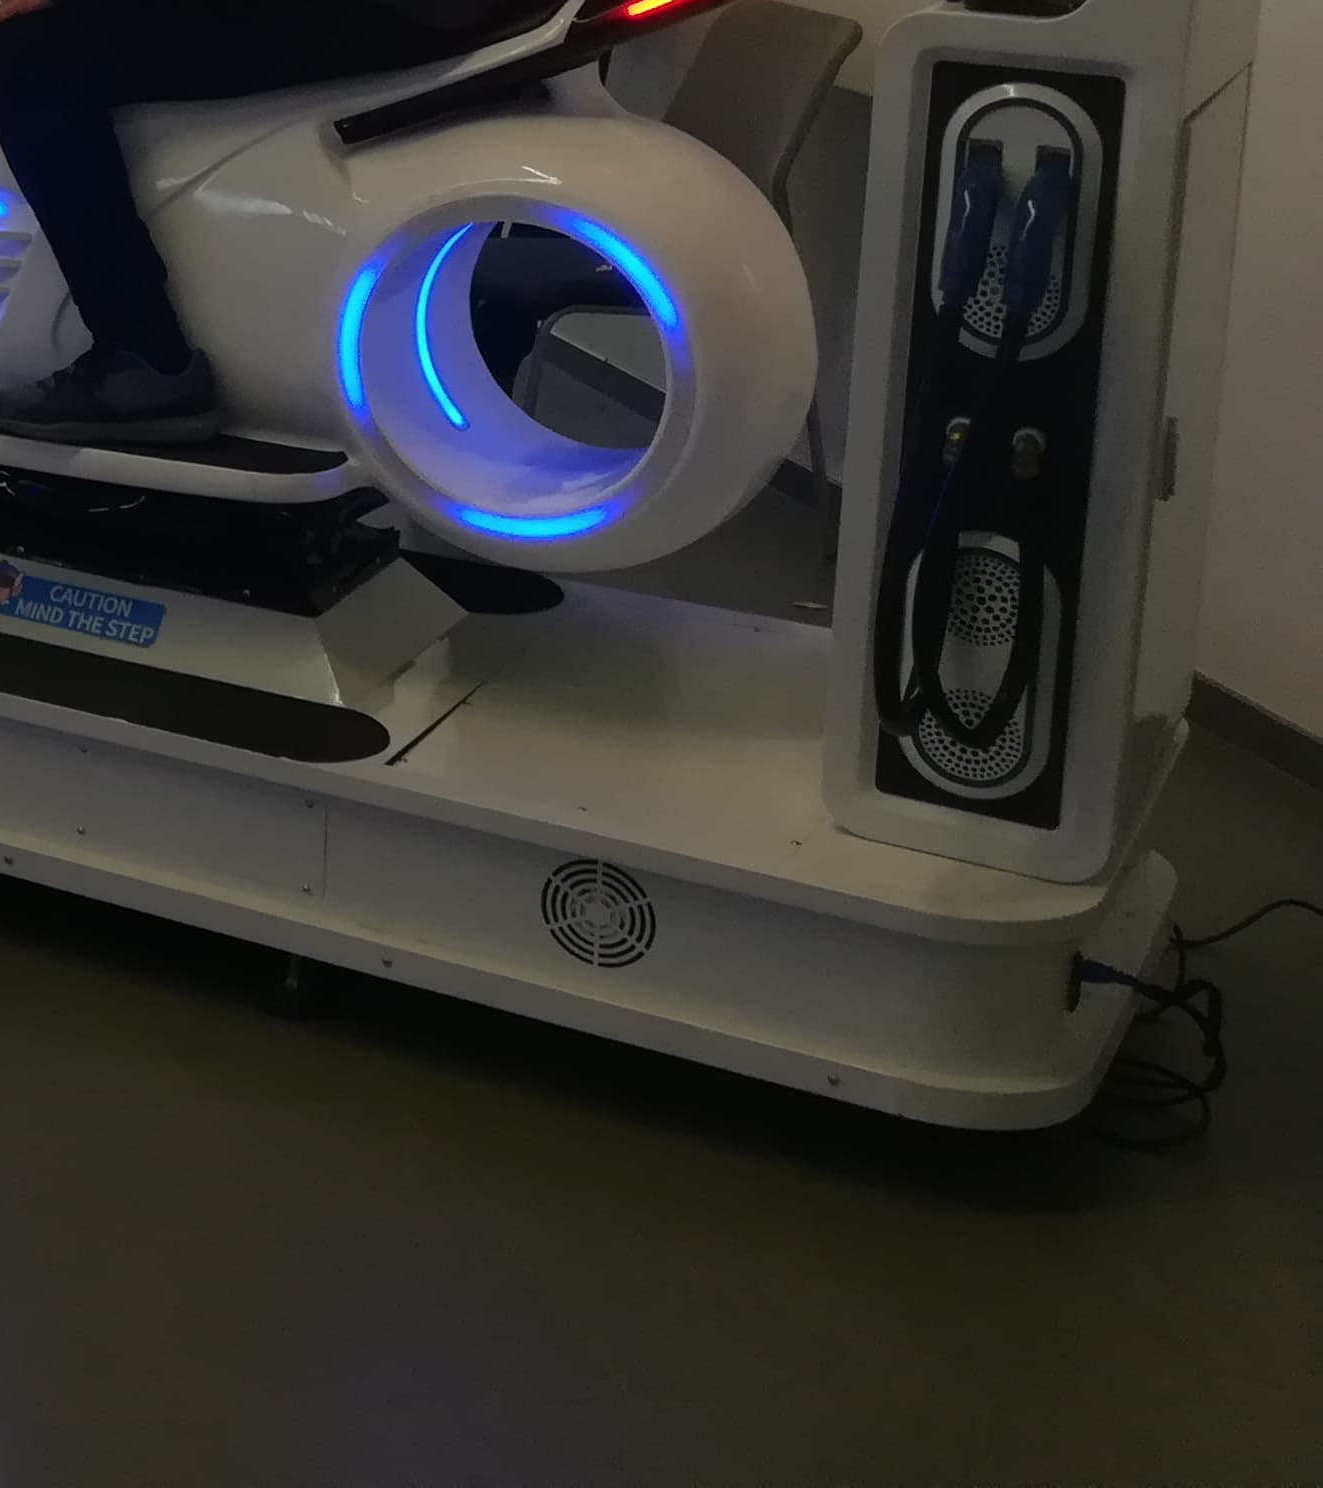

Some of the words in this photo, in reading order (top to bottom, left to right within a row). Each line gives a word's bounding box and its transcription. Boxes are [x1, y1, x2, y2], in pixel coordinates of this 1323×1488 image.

[14, 598, 64, 625] MIND
[67, 609, 106, 634] THE
[105, 620, 156, 644] STEP
[49, 584, 134, 619] CAUTION
